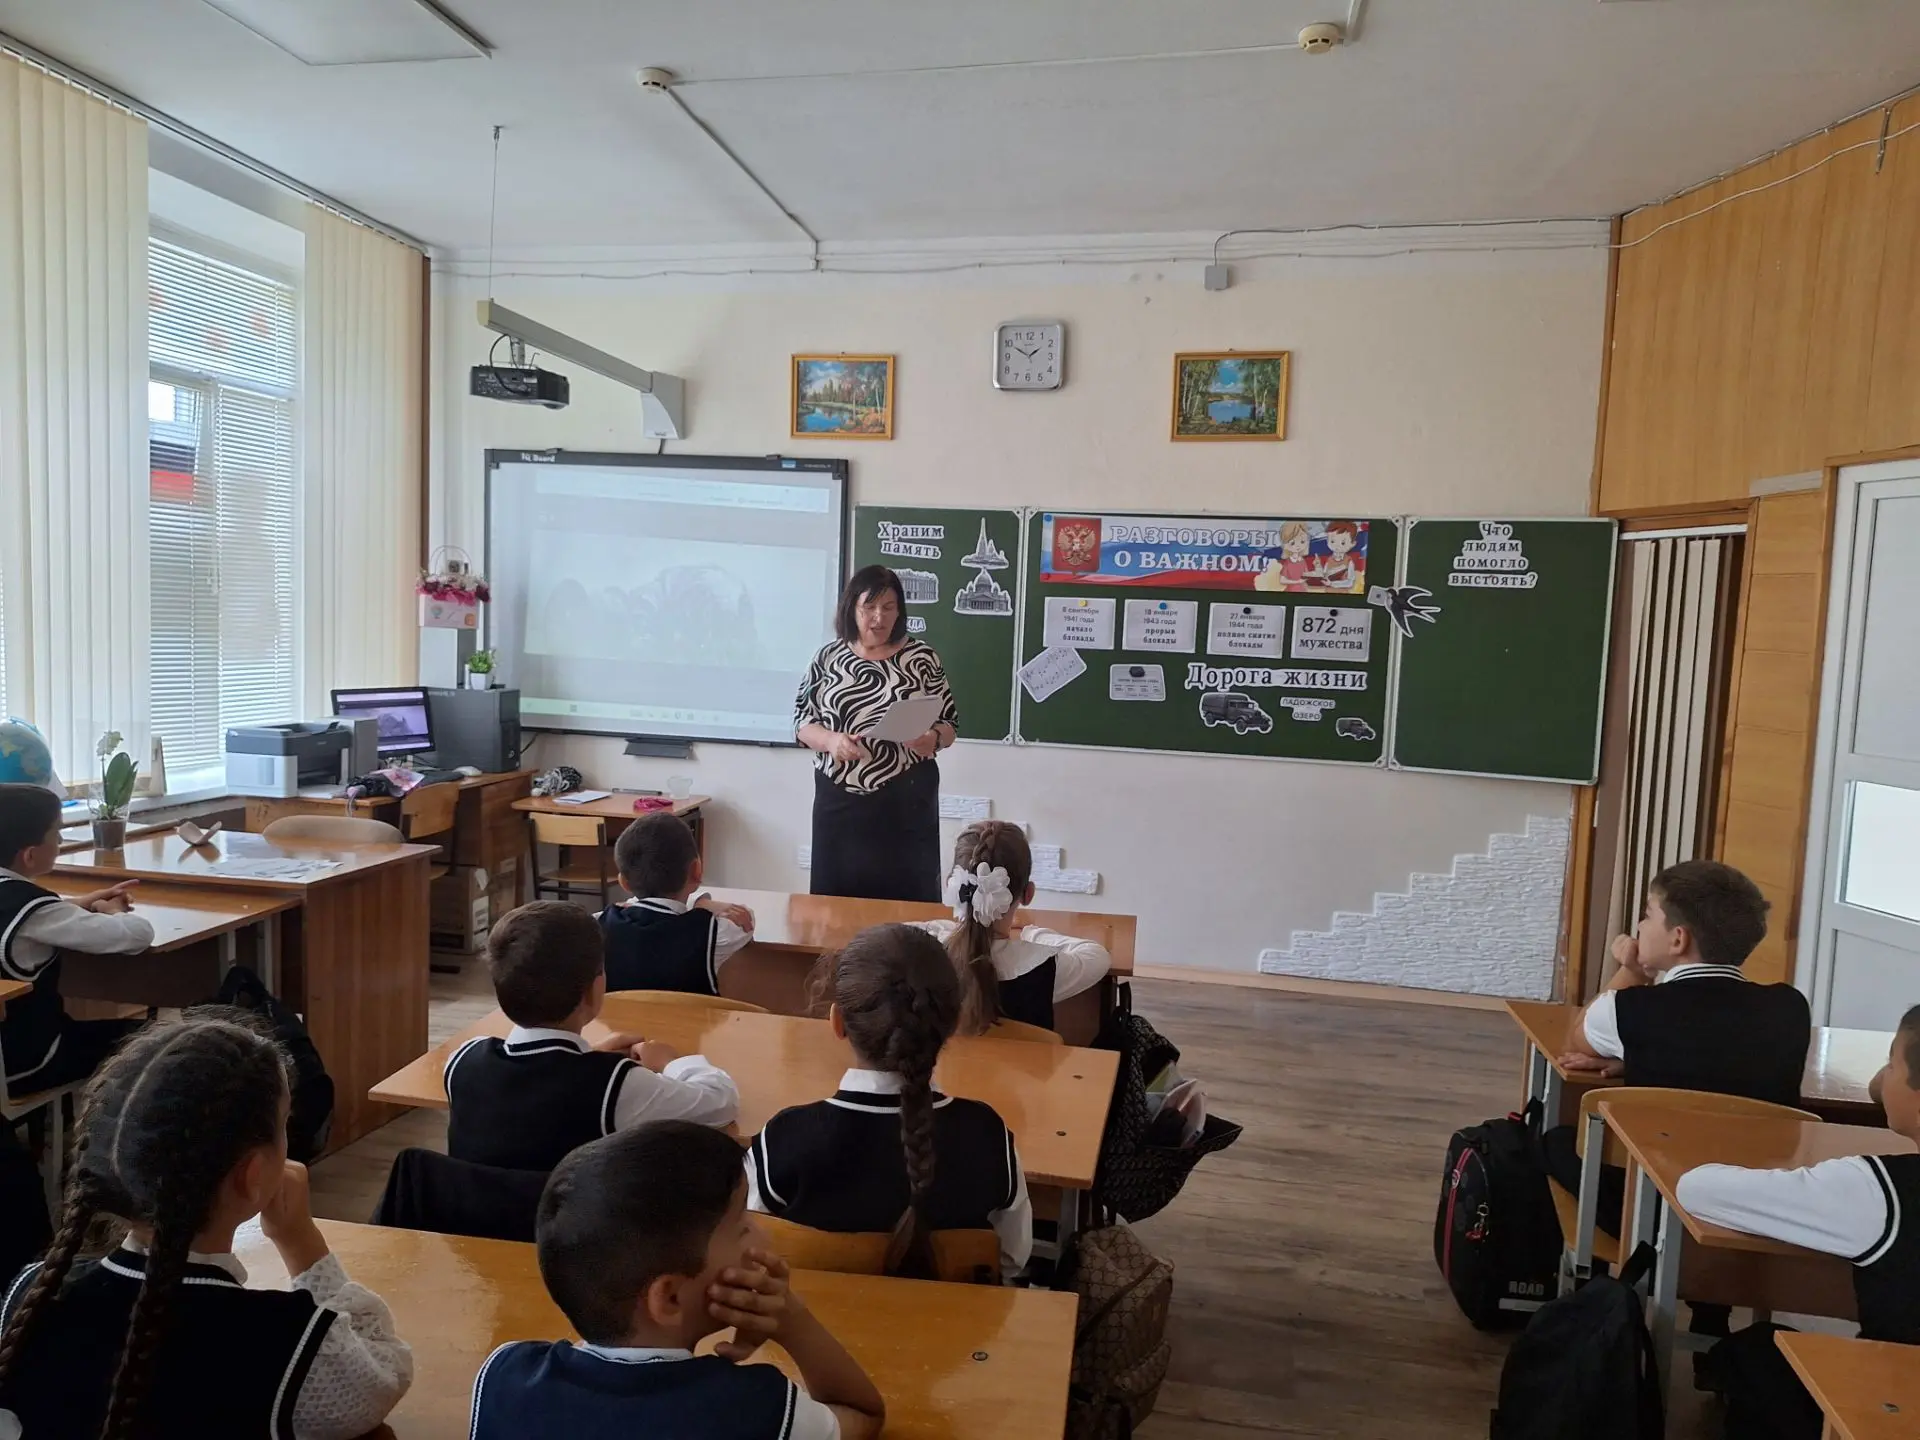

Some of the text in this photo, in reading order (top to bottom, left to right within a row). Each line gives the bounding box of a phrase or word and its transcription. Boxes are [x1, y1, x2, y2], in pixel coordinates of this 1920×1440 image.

[1015, 332, 1022, 340] 11
[1026, 332, 1034, 340] 12
[1048, 339, 1054, 348] 2
[1005, 353, 1011, 361] 9
[1048, 352, 1053, 360] 3
[1004, 366, 1010, 374] 8
[1014, 373, 1019, 381] 7
[1025, 373, 1031, 381] 6
[1038, 373, 1043, 381] 5
[880, 523, 943, 540] Храним
[1481, 523, 1511, 536] Что
[1110, 525, 1278, 548] РАЗГОВОРЫ
[882, 542, 940, 558] память
[1464, 542, 1519, 553] людям
[1114, 550, 1132, 568] О
[1456, 558, 1526, 569] помогло
[1451, 573, 1536, 586] выстоять?
[1302, 617, 1364, 636] 872 дня
[1062, 633, 1096, 642] блокады
[1143, 636, 1177, 644] блокады
[1228, 640, 1263, 648] блокады
[1299, 638, 1363, 650] мужества
[1188, 665, 1366, 689] Дорога жизни
